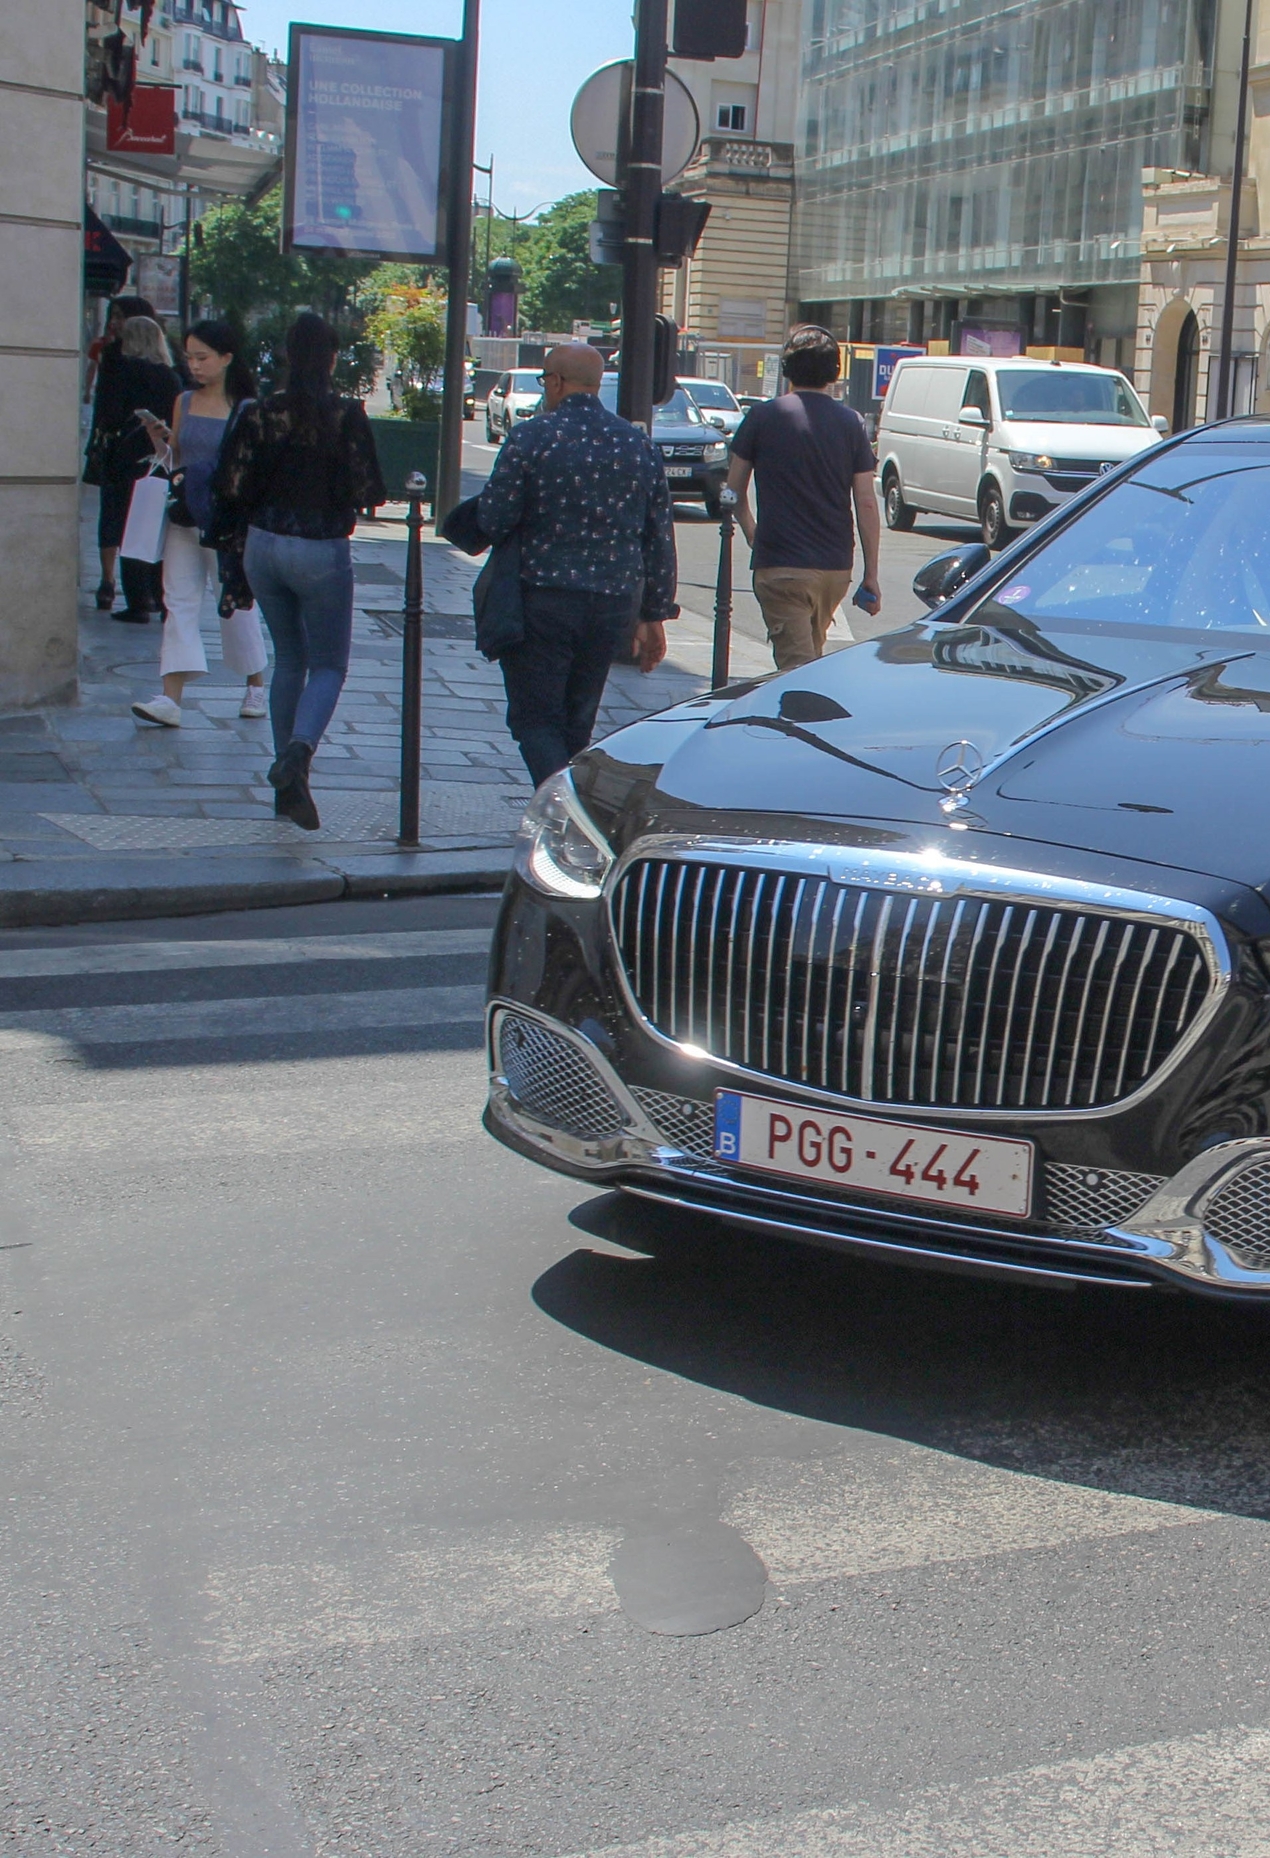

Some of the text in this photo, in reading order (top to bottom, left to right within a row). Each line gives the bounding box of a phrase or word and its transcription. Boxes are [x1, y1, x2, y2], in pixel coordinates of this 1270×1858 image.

[308, 80, 422, 100] UNE COLLECTION
[308, 93, 404, 111] HOLLANDAISE
[719, 1132, 736, 1155] B
[768, 1112, 981, 1197] PGG-444
